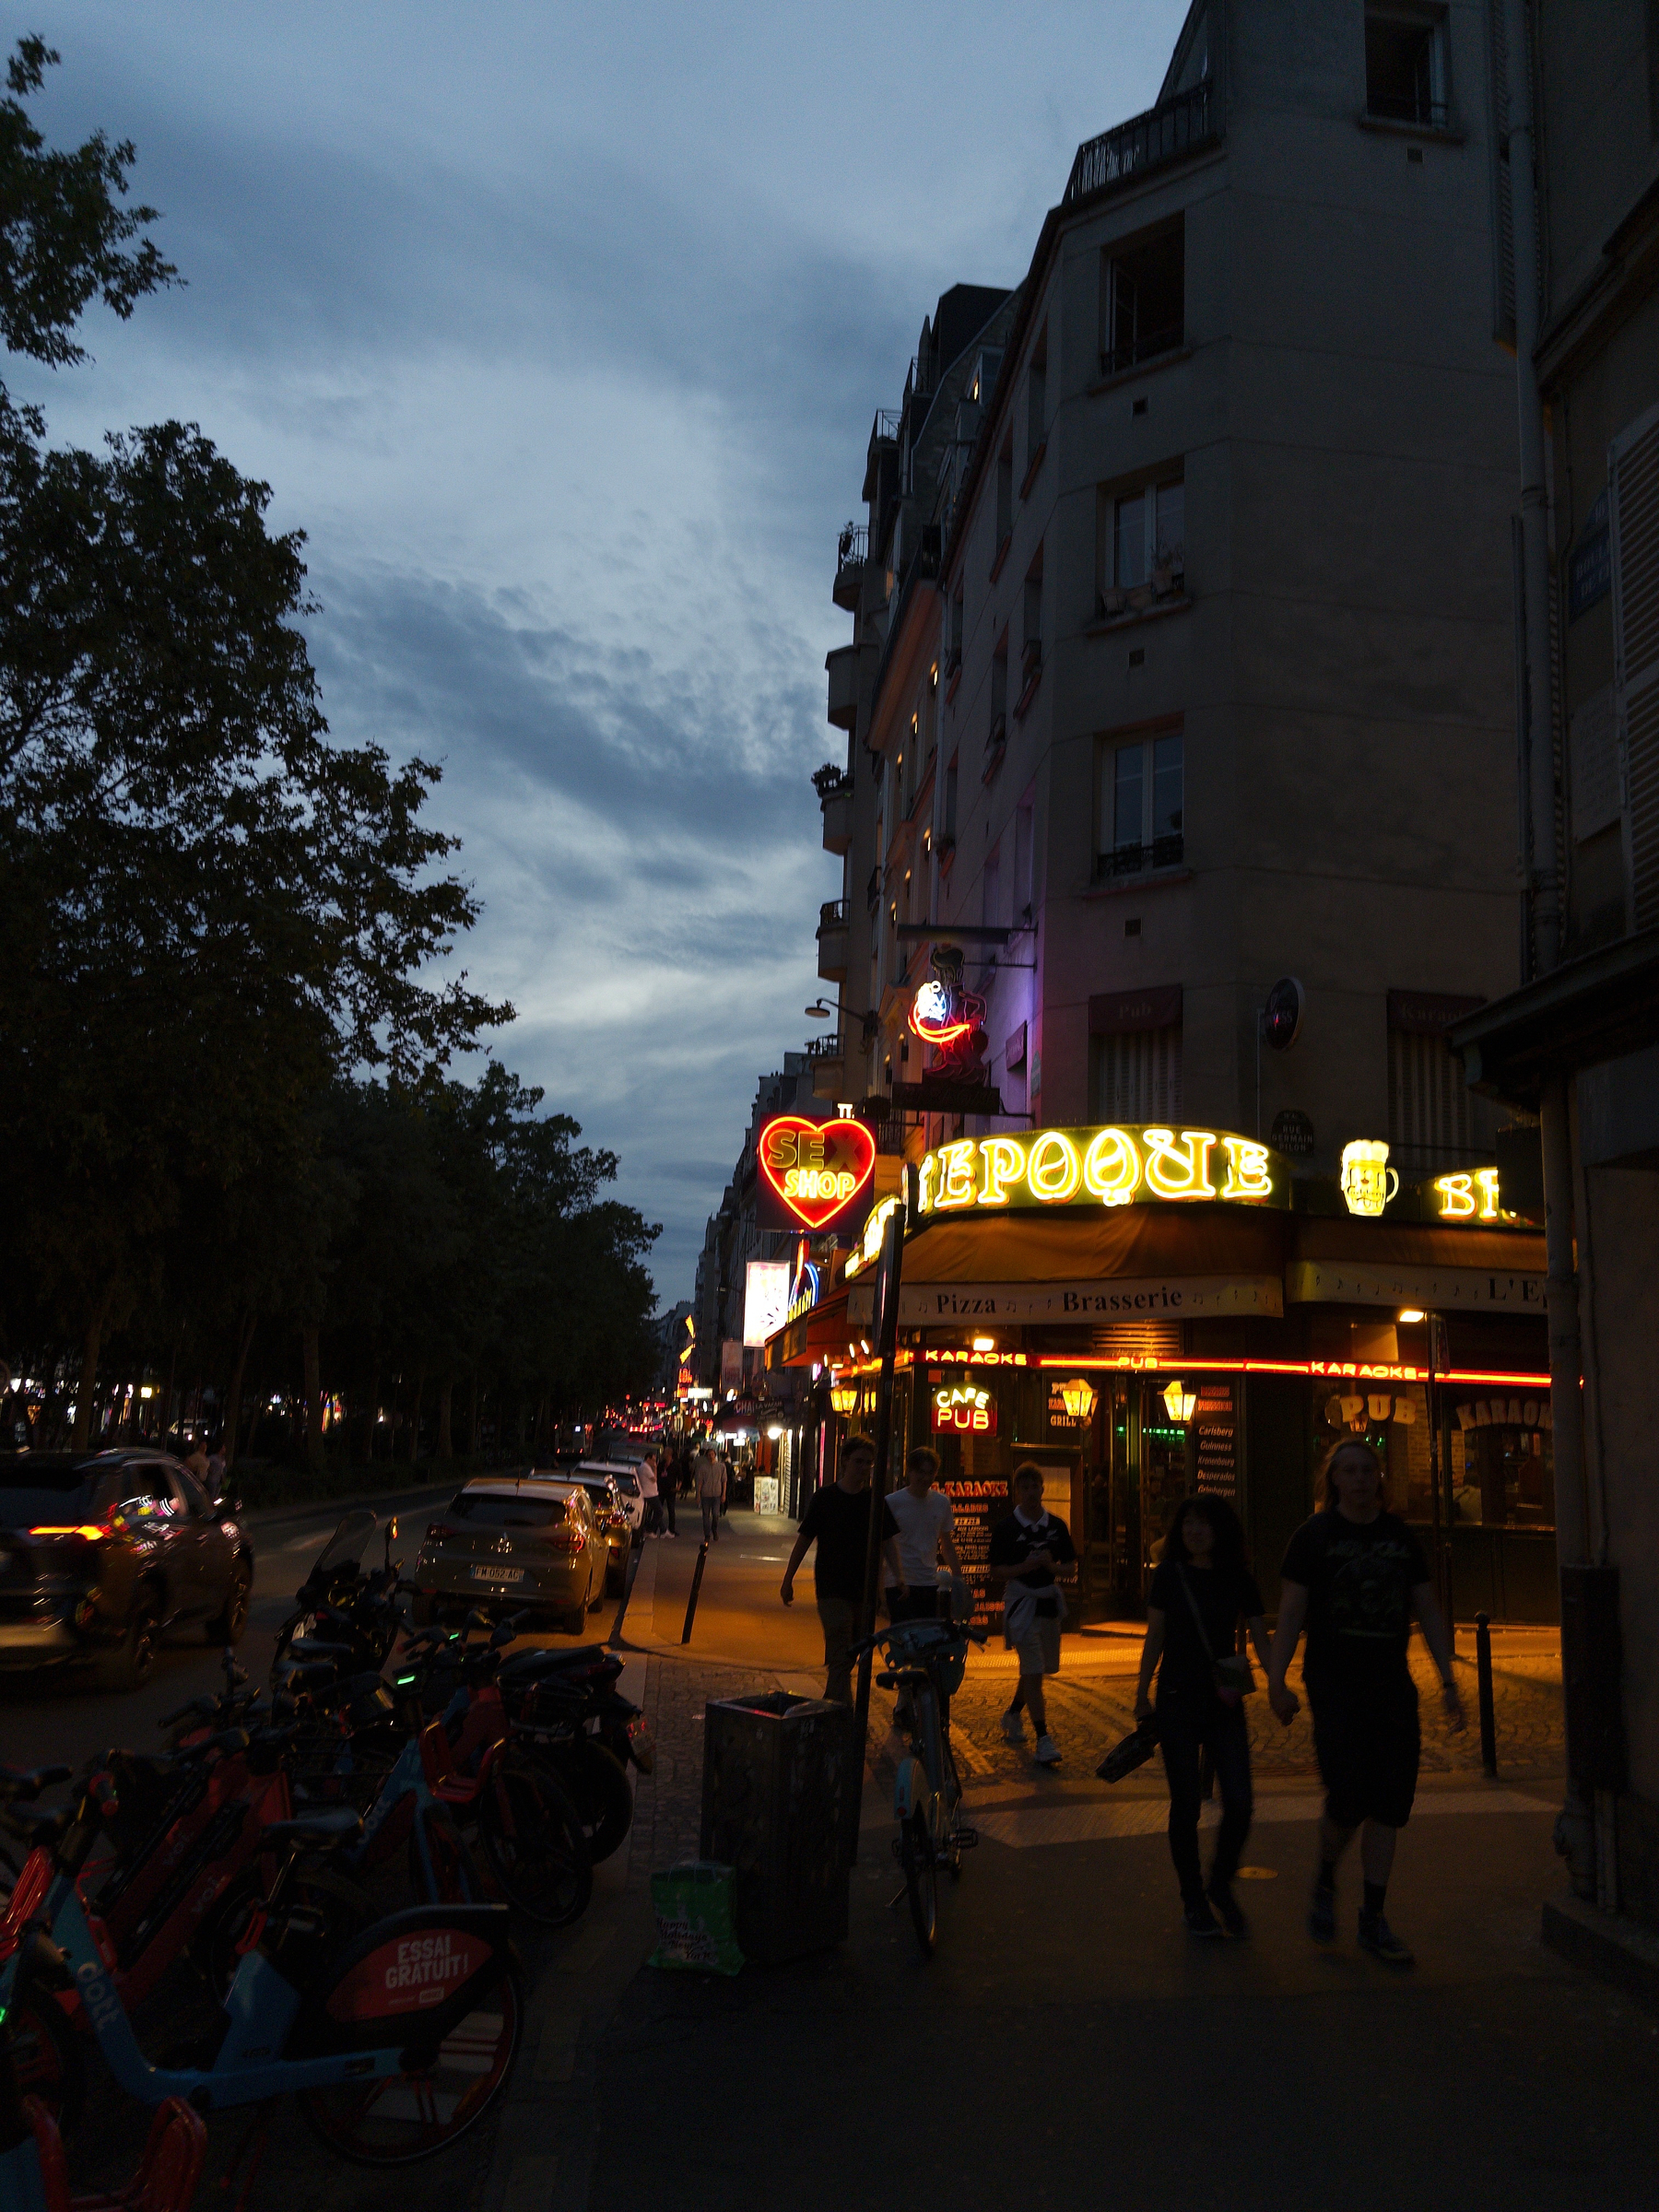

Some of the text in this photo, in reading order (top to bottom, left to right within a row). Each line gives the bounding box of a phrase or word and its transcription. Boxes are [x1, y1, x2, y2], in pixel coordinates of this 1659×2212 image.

[1119, 1002, 1152, 1020] Pub
[1271, 1133, 1313, 1144] GERMAIN
[1282, 1124, 1300, 1135] RUE
[767, 1128, 863, 1171] SEX
[783, 1169, 856, 1200] SHOP
[936, 1286, 1183, 1315] Pizza Brasserie
[1488, 1277, 1548, 1309] L'E
[924, 1349, 1027, 1366] KARAOKE
[1118, 1357, 1159, 1370] PUB
[1311, 1360, 1418, 1380] KARAOKE
[936, 1386, 990, 1410] CAFE
[1340, 1393, 1418, 1425] PUB
[936, 1408, 991, 1430] PUB
[1050, 1415, 1077, 1428] GRILL
[1198, 1426, 1233, 1439] Carlsberg
[1200, 1440, 1232, 1452] Guinness
[1197, 1455, 1235, 1468] Kronenbourg
[1196, 1469, 1236, 1483] Desperados
[397, 1935, 452, 1965] ESSAI
[76, 1961, 121, 2033] dott
